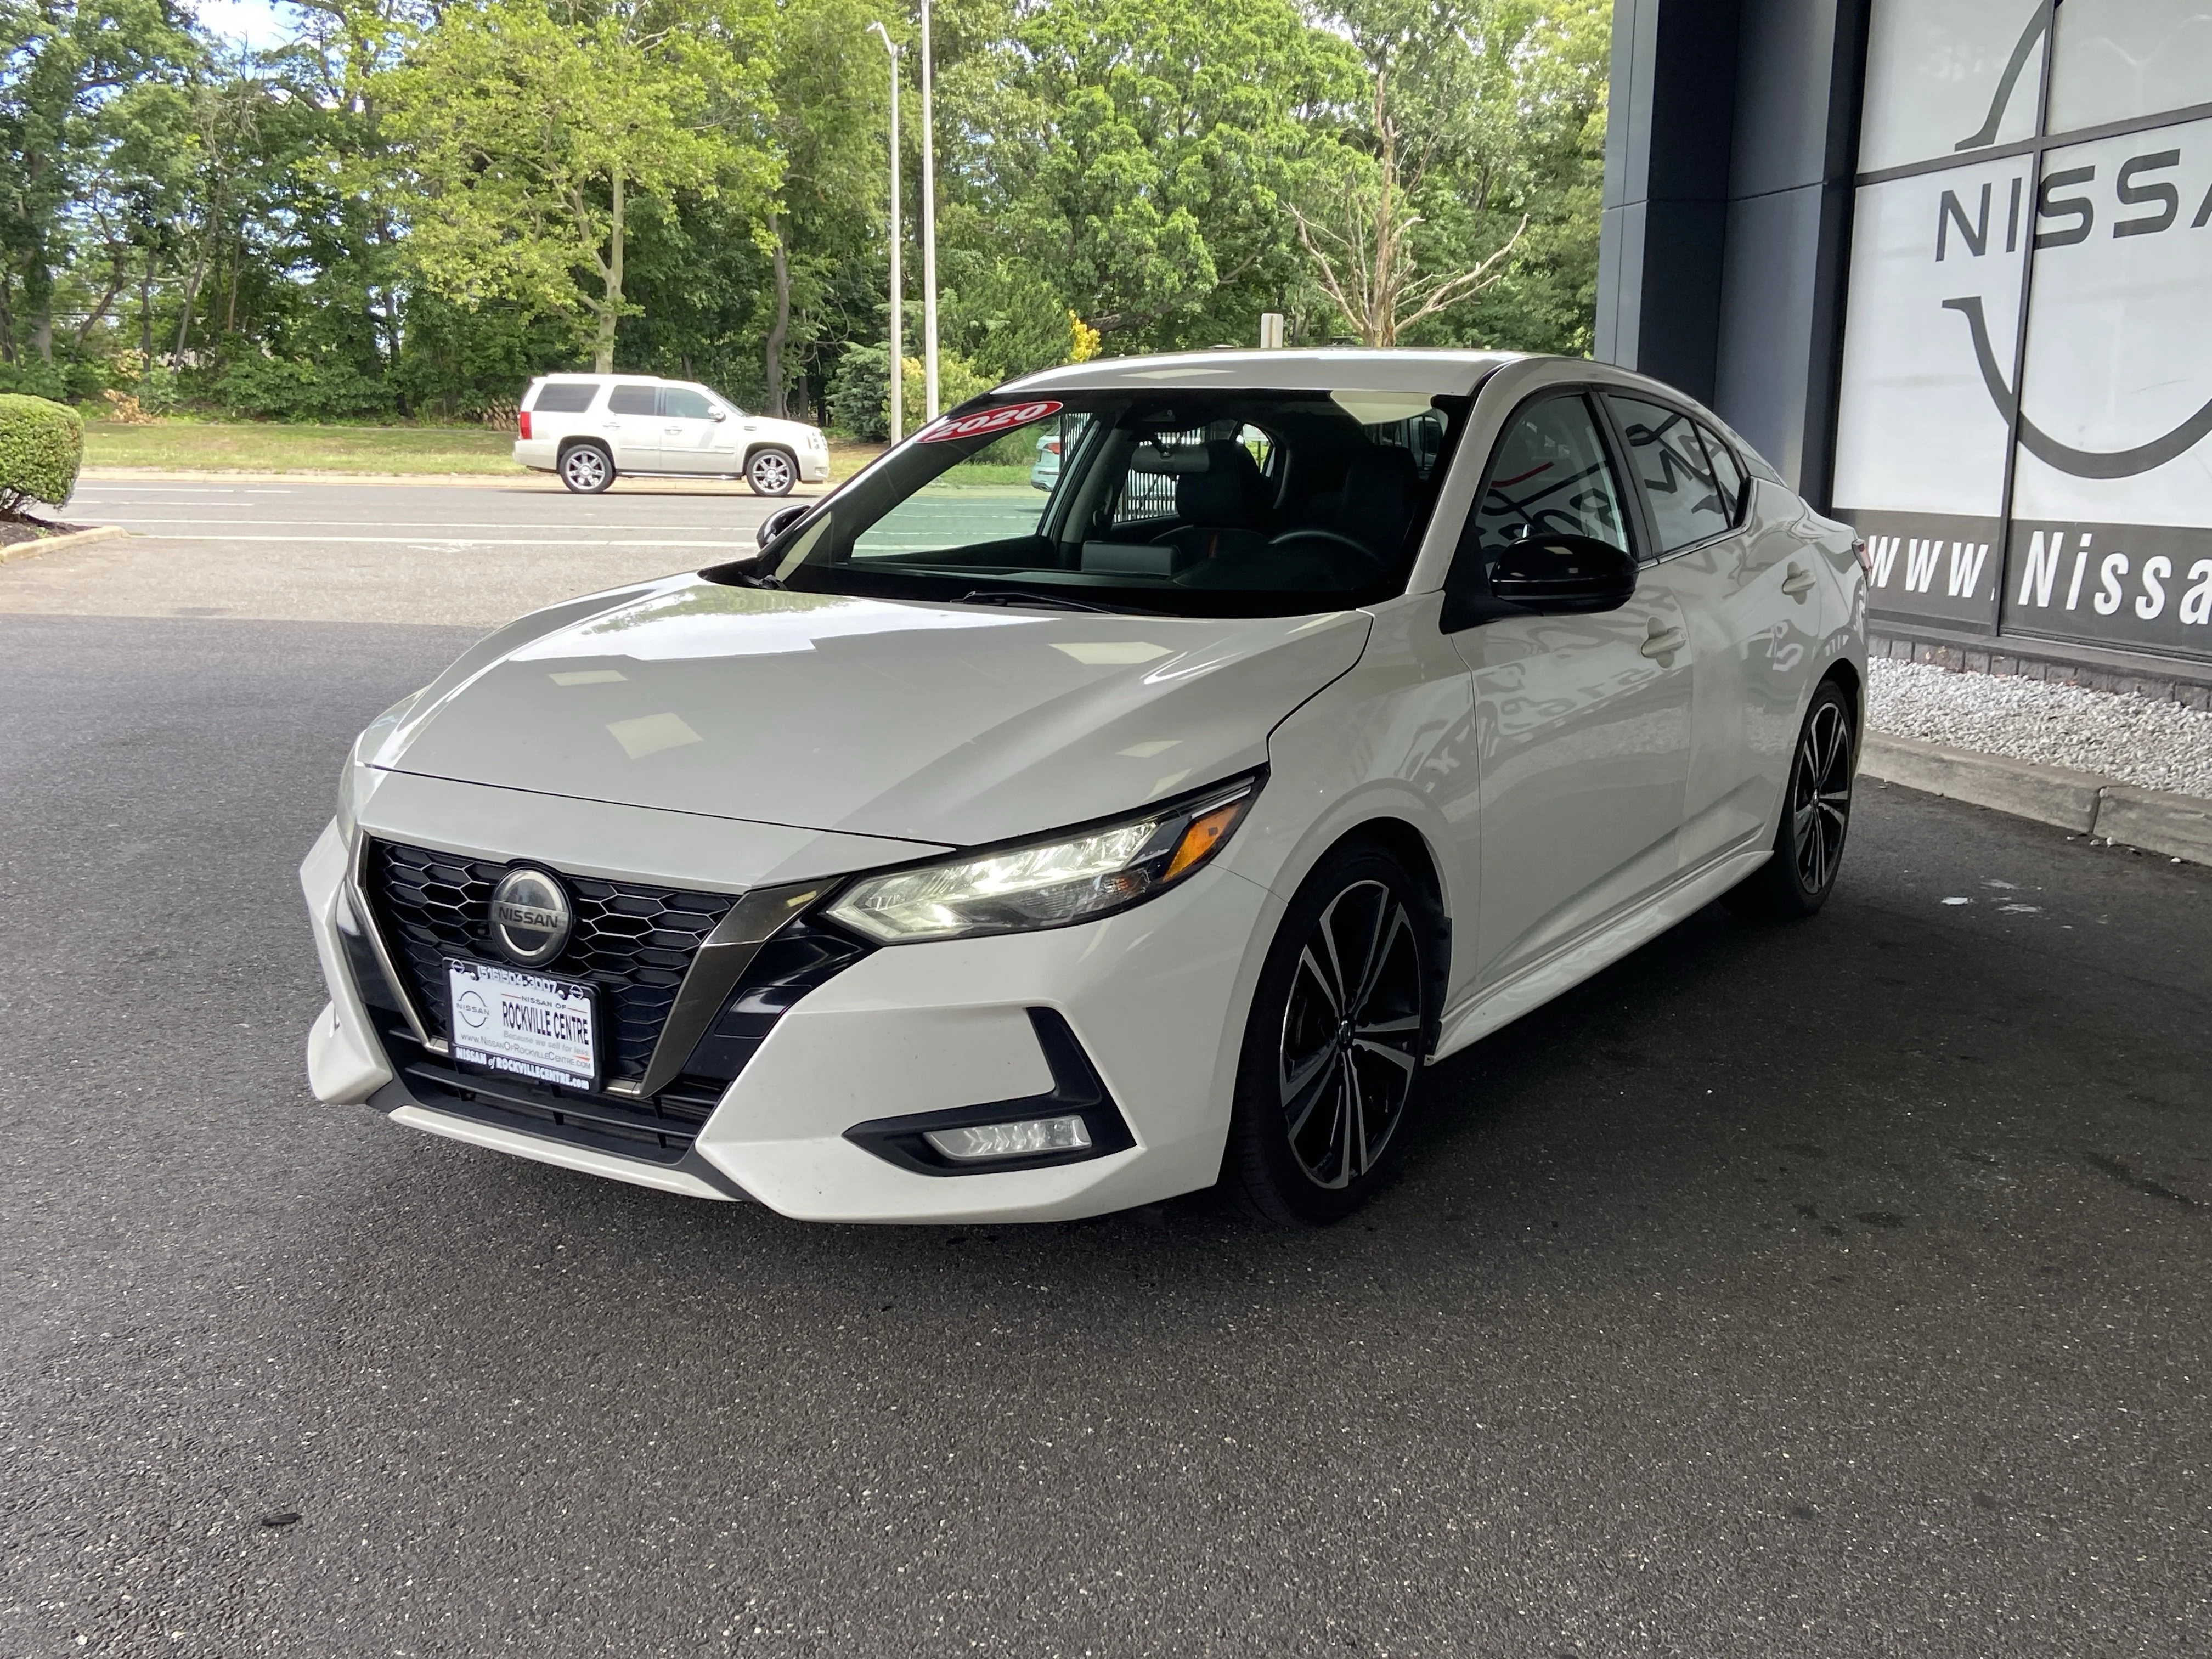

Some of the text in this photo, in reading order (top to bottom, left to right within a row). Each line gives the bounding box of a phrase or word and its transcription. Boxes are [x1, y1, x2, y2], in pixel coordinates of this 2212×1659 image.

[1935, 148, 2212, 262] NISS
[923, 404, 1048, 441] 2020
[498, 906, 558, 928] NISSAN
[456, 1003, 489, 1015] NISSAN
[522, 996, 552, 1007] NISSAN
[503, 1001, 589, 1045] ROCKVILLE CENTRE
[504, 1030, 533, 1043] Because
[562, 1043, 572, 1052] for
[456, 1047, 487, 1065] NISSAN
[488, 1056, 496, 1070] of
